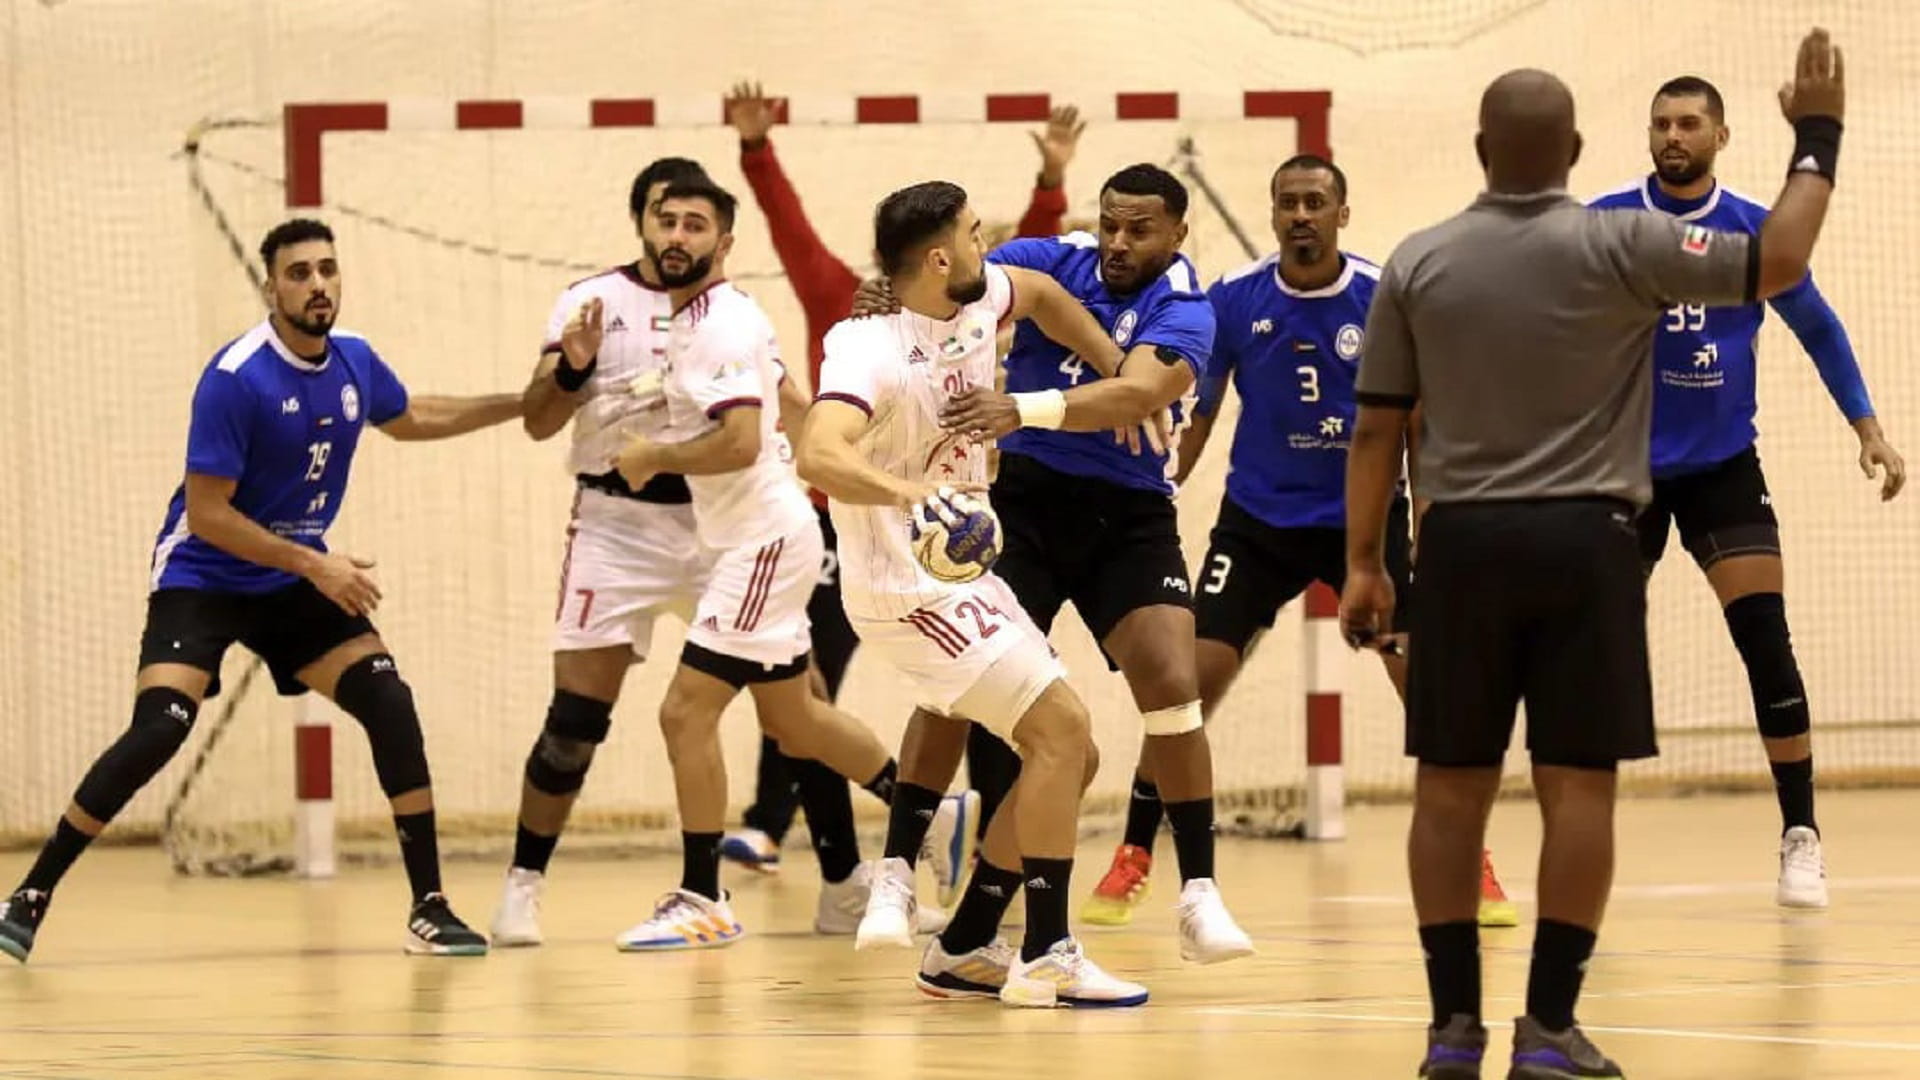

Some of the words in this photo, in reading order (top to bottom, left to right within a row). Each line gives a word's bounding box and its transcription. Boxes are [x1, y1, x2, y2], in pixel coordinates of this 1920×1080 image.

[1059, 353, 1083, 385] 4
[1296, 366, 1320, 401] 3
[303, 441, 332, 481] 19
[1204, 554, 1232, 594] 3
[575, 589, 595, 629] 7
